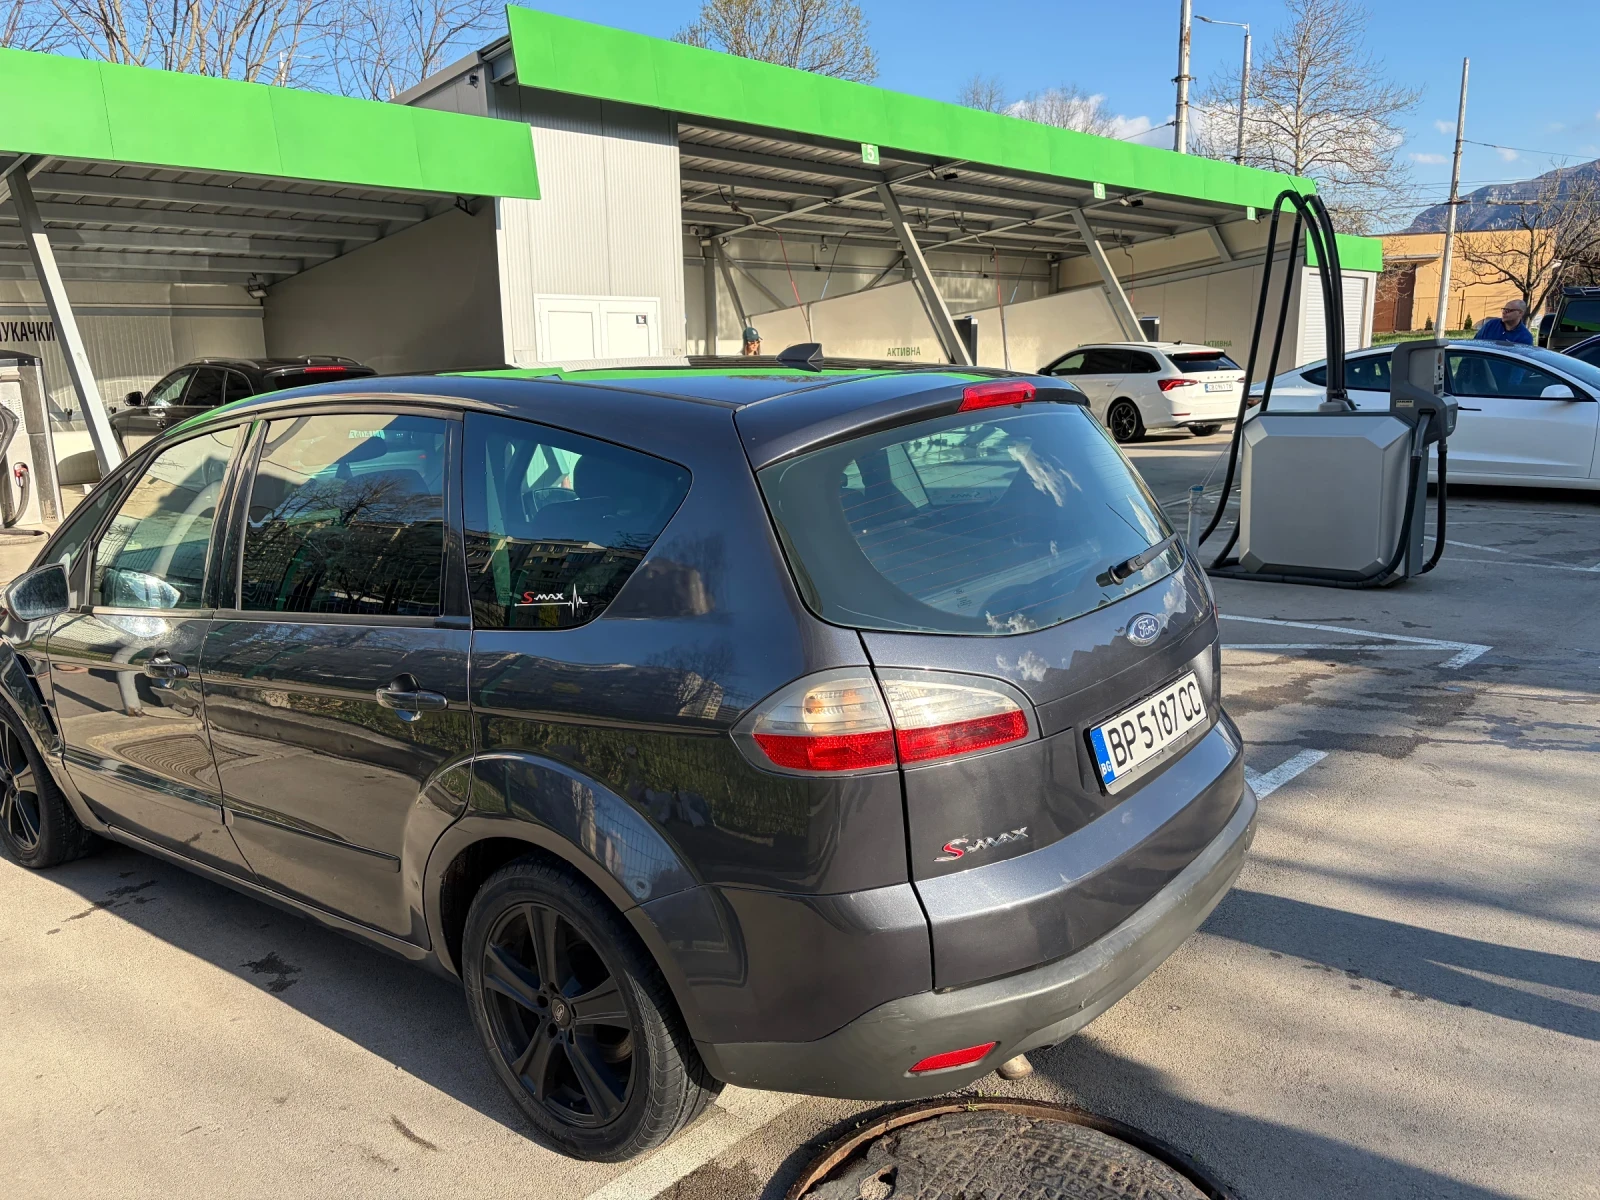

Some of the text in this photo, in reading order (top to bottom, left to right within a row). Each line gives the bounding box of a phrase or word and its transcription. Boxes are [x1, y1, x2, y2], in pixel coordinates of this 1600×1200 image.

[867, 145, 875, 161] 5
[0, 321, 56, 342] УКАЧКИ
[886, 346, 921, 357] АКТИВНА
[1137, 618, 1156, 638] Ford
[1136, 692, 1179, 749] 5187
[1178, 681, 1202, 722] CC
[1100, 760, 1113, 776] BG
